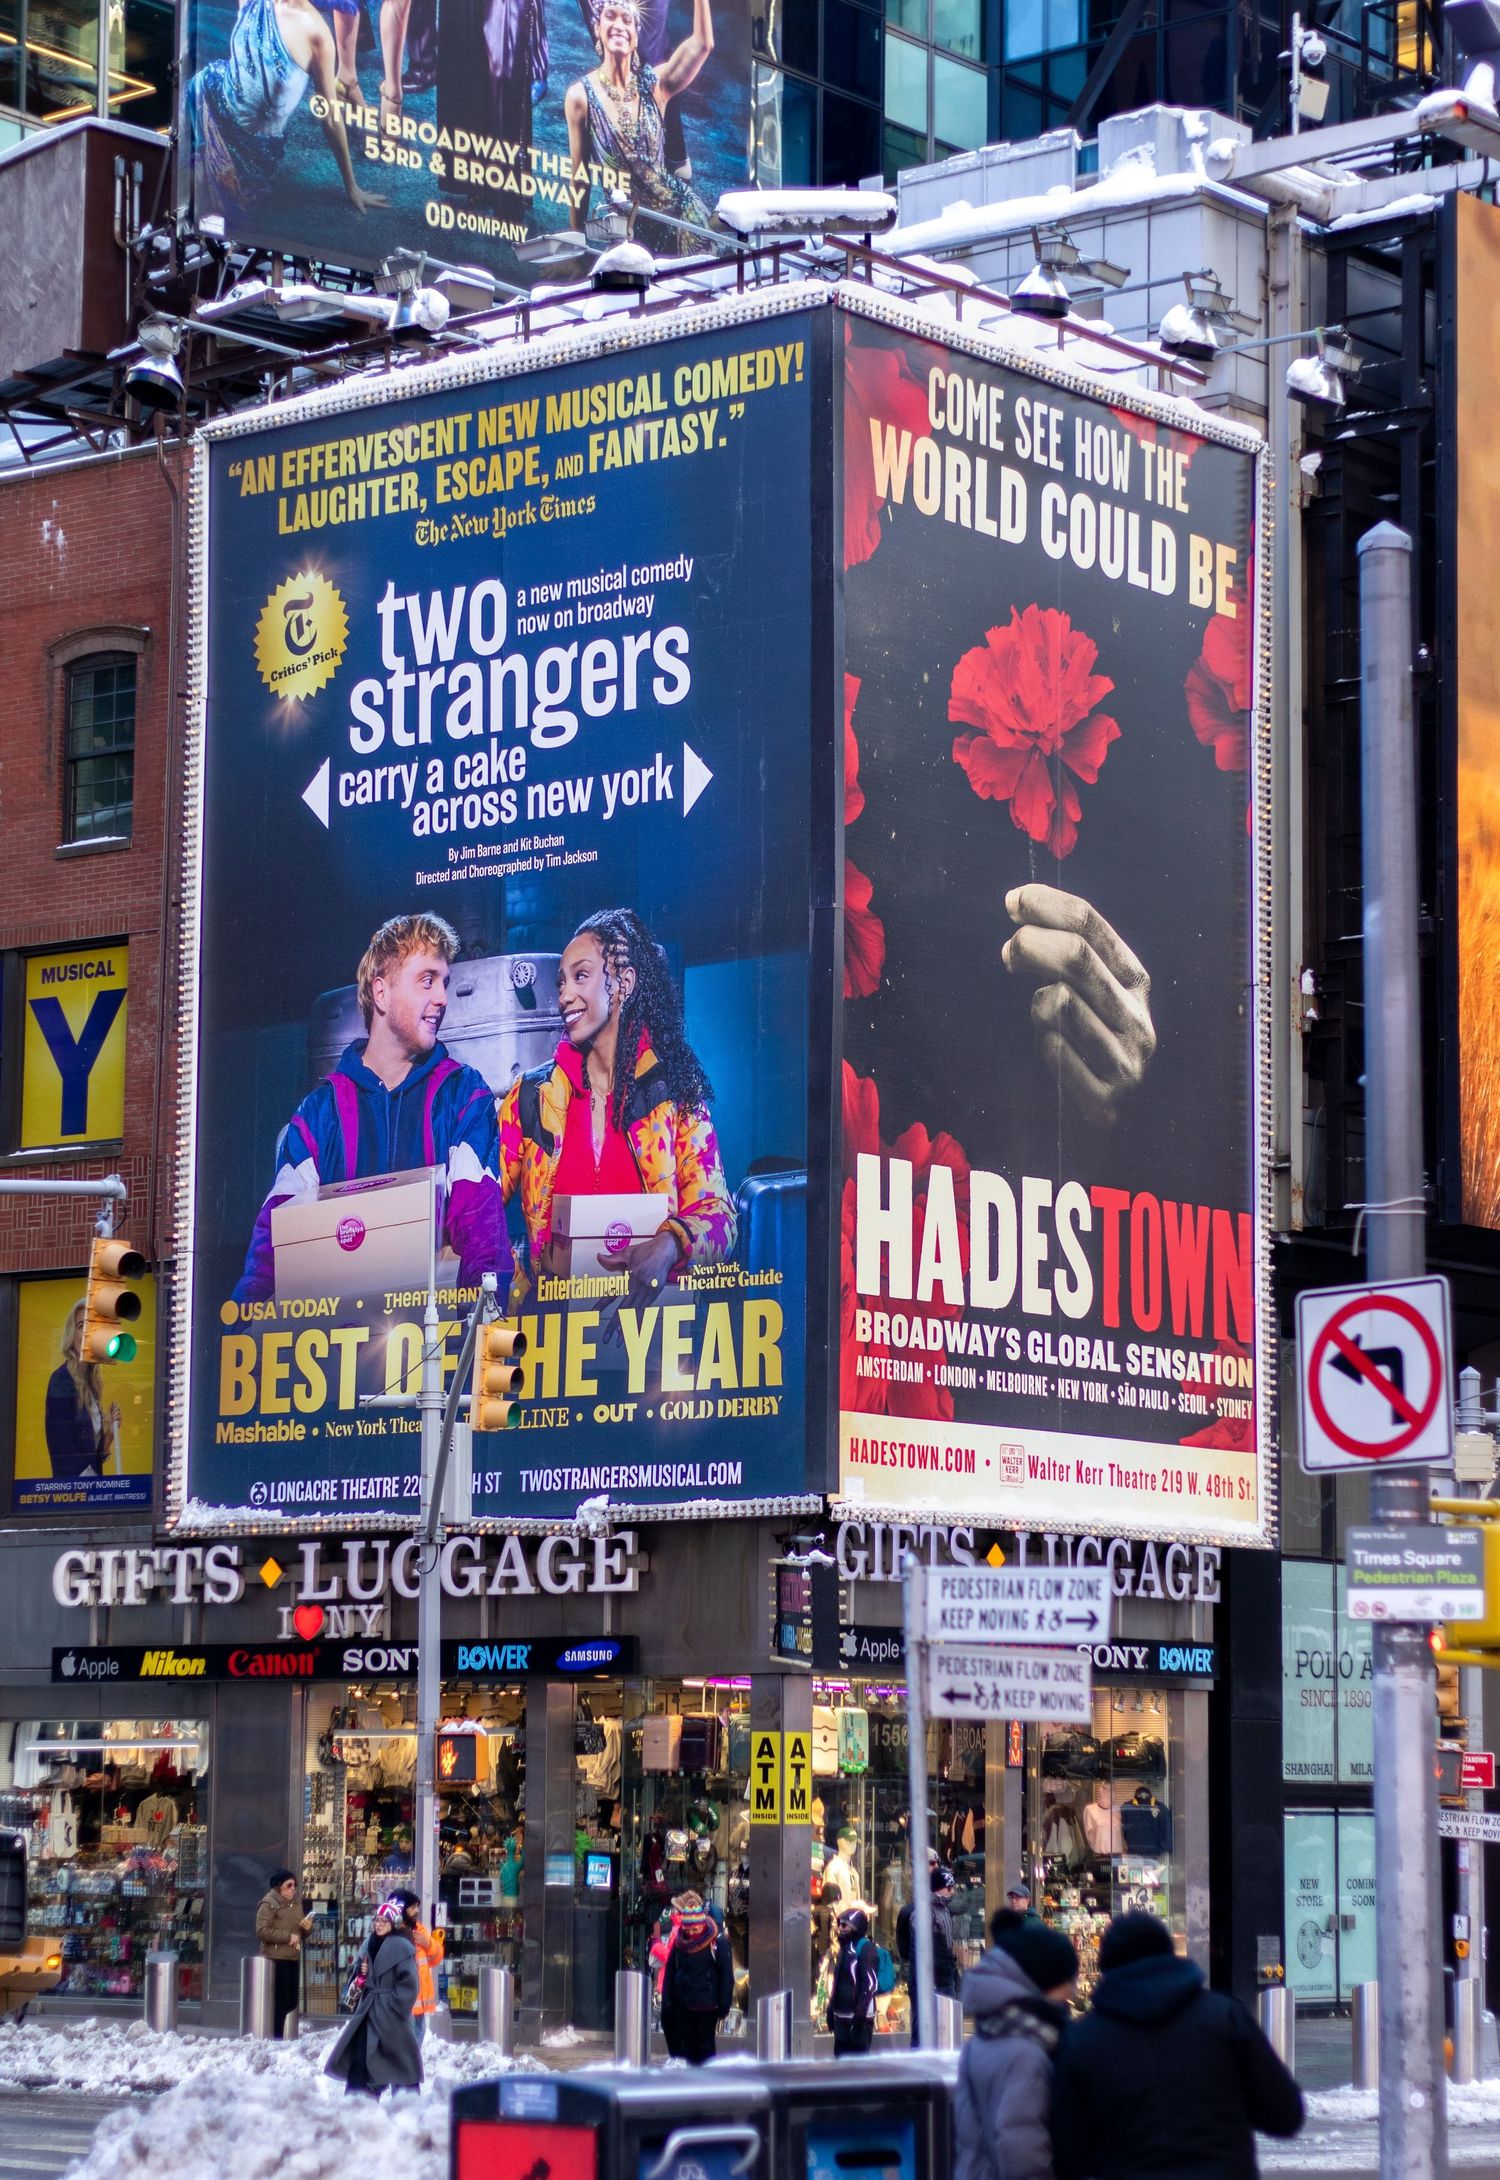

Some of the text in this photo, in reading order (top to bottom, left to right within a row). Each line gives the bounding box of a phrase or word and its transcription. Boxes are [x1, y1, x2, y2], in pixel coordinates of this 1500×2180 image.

[330, 98, 631, 195] THE BROADWAY THEATRE
[364, 137, 586, 208] 53RD & BROADWAY
[425, 201, 528, 242] OD COMPANY
[229, 342, 804, 496] “AN EFFERVESCENT NEW MUSICAL COMEDY!
[928, 366, 1189, 514] COME SEE HOW THE
[279, 402, 744, 535] LAUGHTER, ESCAPE, AND FANTASY.”
[415, 493, 596, 547] The New York Times
[869, 417, 1237, 619] WORLD COULD BE
[517, 555, 694, 608] a new musical comedy
[377, 579, 507, 670] two
[517, 593, 655, 636] now on broadway
[270, 647, 339, 684] Critics’ Pick
[350, 625, 691, 754] strangers
[339, 737, 527, 809] carry a cake
[413, 752, 674, 837] across new york
[449, 834, 564, 862] By Jim Barne and Kit Buchan
[416, 850, 598, 885] Directed and Choreographed by Tim Jackson
[41, 959, 115, 984] MUSICAL
[29, 989, 127, 1136] Y
[856, 1152, 1252, 1343] HADESTOWN
[240, 1262, 740, 1321] USA TODAY Entertainment New York
[677, 1270, 783, 1291] Theatre Guide
[219, 1326, 370, 1416] BEST
[491, 1310, 600, 1400] HE
[618, 1298, 783, 1394] YEAR
[856, 1309, 1253, 1389] BROADWAY'S GLOBAL SENSATION
[856, 1355, 1252, 1420] AMSTERDAM LONDON MELBOURNE NEW YORK SÃO PAULO SEOUL SYDNEY
[216, 1395, 783, 1444] Mashable New York OUT GOLD DERBY
[35, 1482, 71, 1491] STARRING
[96, 1480, 130, 1488] NOMINEE
[270, 1480, 337, 1502] LONGACRE
[341, 1477, 398, 1500] THEATRE
[485, 1471, 502, 1493] ST
[520, 1461, 742, 1492] TWOSTRANGERSMUSICAL.COM
[850, 1437, 1255, 1500] HADESTOWN.COM Walter Kerr Theatre 219 W. 48th St.
[20, 1494, 50, 1504] BETSY
[53, 1493, 86, 1503] WOLFE
[52, 1531, 639, 1608] GIFTS LUGGAGE
[1353, 1550, 1461, 1568] Times Square
[1354, 1569, 1477, 1584] Pedestrian Plaza
[941, 1577, 1102, 1600] PEDESTRIAN FLOW ZONE
[277, 1604, 388, 1640] I NY
[941, 1611, 1029, 1631] KEEP MOVING
[139, 1651, 206, 1676] Nikon
[228, 1650, 315, 1677] Canon
[458, 1645, 529, 1670] BOWER
[564, 1649, 613, 1662] SAMSUNG
[861, 1637, 899, 1659] Apple
[1077, 1645, 1147, 1669] SONY
[1159, 1647, 1212, 1672] BOWER
[1296, 1650, 1354, 1679] POLO
[79, 1657, 119, 1678] Apple
[938, 1657, 1083, 1683] PEDESTRIAN FLOW ZONE
[1004, 1690, 1085, 1711] KEEP MOVING
[1344, 1690, 1371, 1708] 1890
[756, 1737, 775, 1810] ATM
[790, 1737, 806, 1810] ATM
[1285, 1763, 1333, 1776] SHANGHAI
[1296, 1895, 1376, 1907] STORE SOON
[1300, 1879, 1319, 1890] NEW
